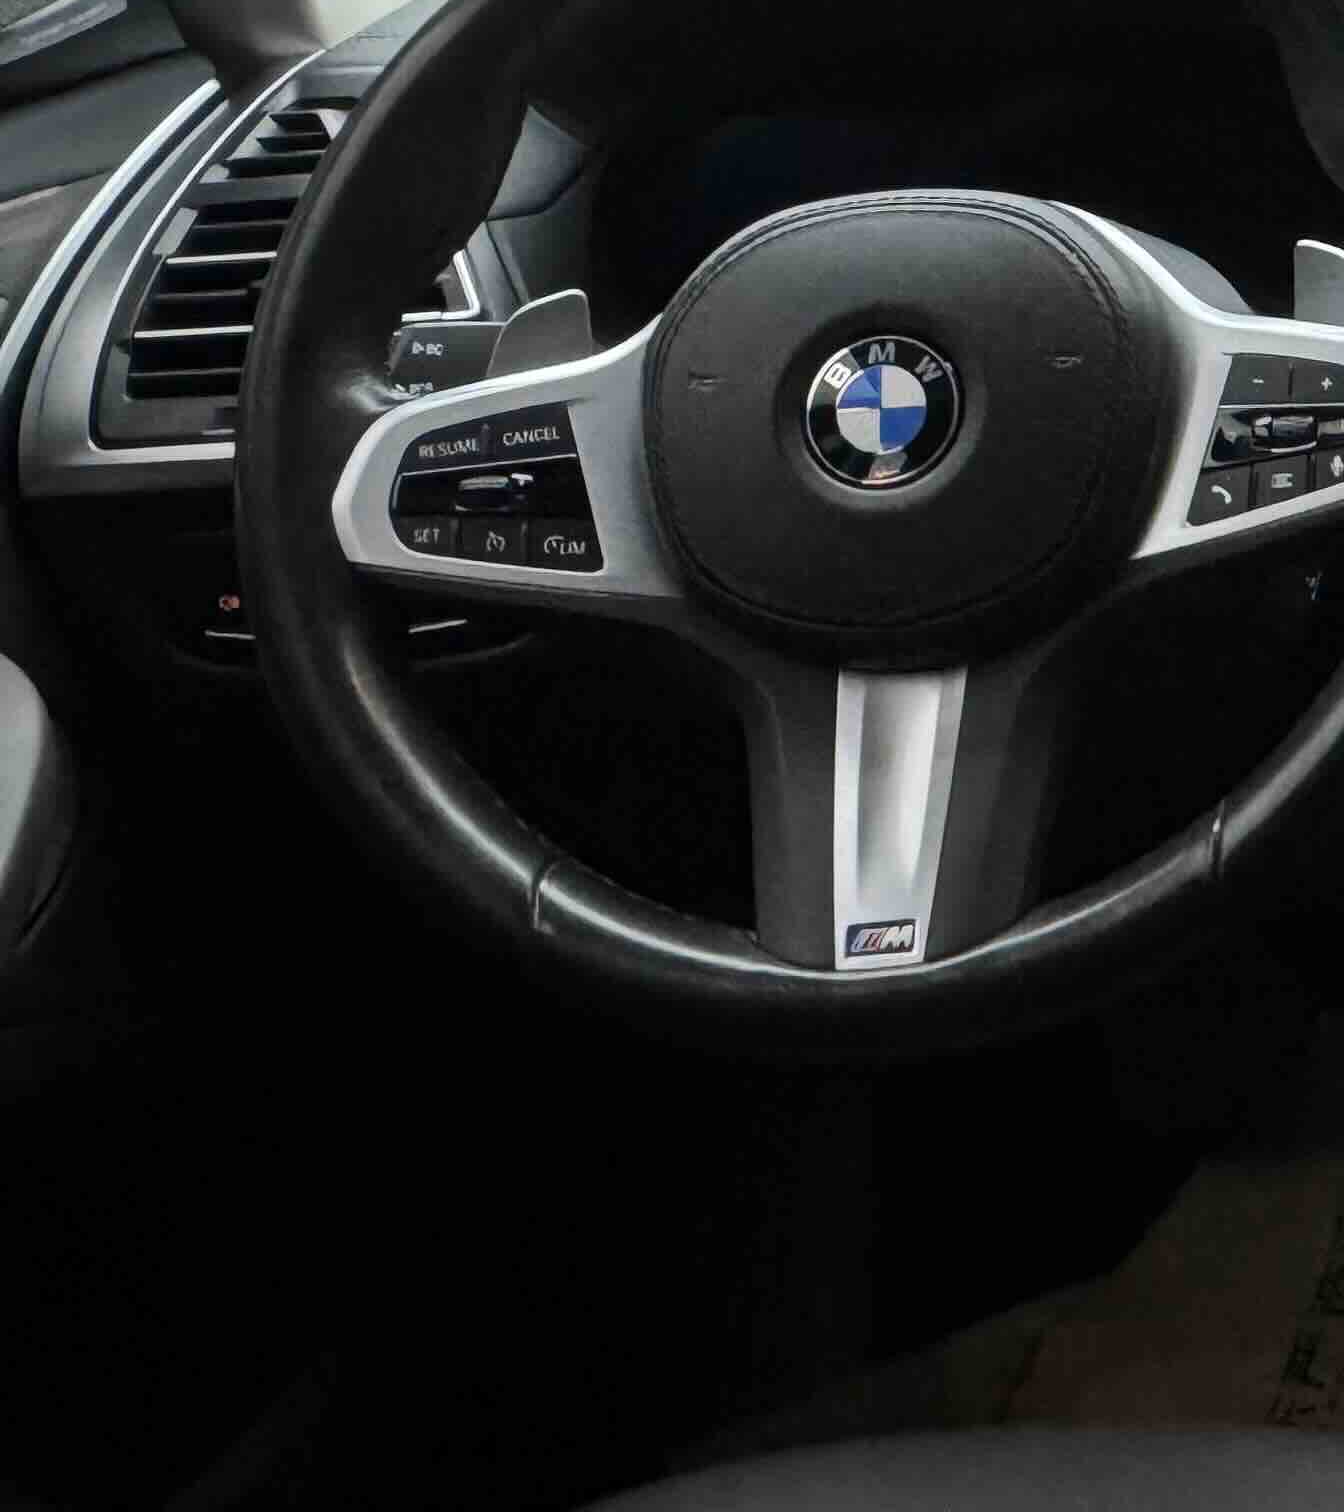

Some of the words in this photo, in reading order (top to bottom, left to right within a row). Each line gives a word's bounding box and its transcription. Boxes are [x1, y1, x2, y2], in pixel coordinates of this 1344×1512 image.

[502, 426, 561, 447] CANCEL
[418, 438, 481, 458] RESUME
[413, 527, 440, 544] SET
